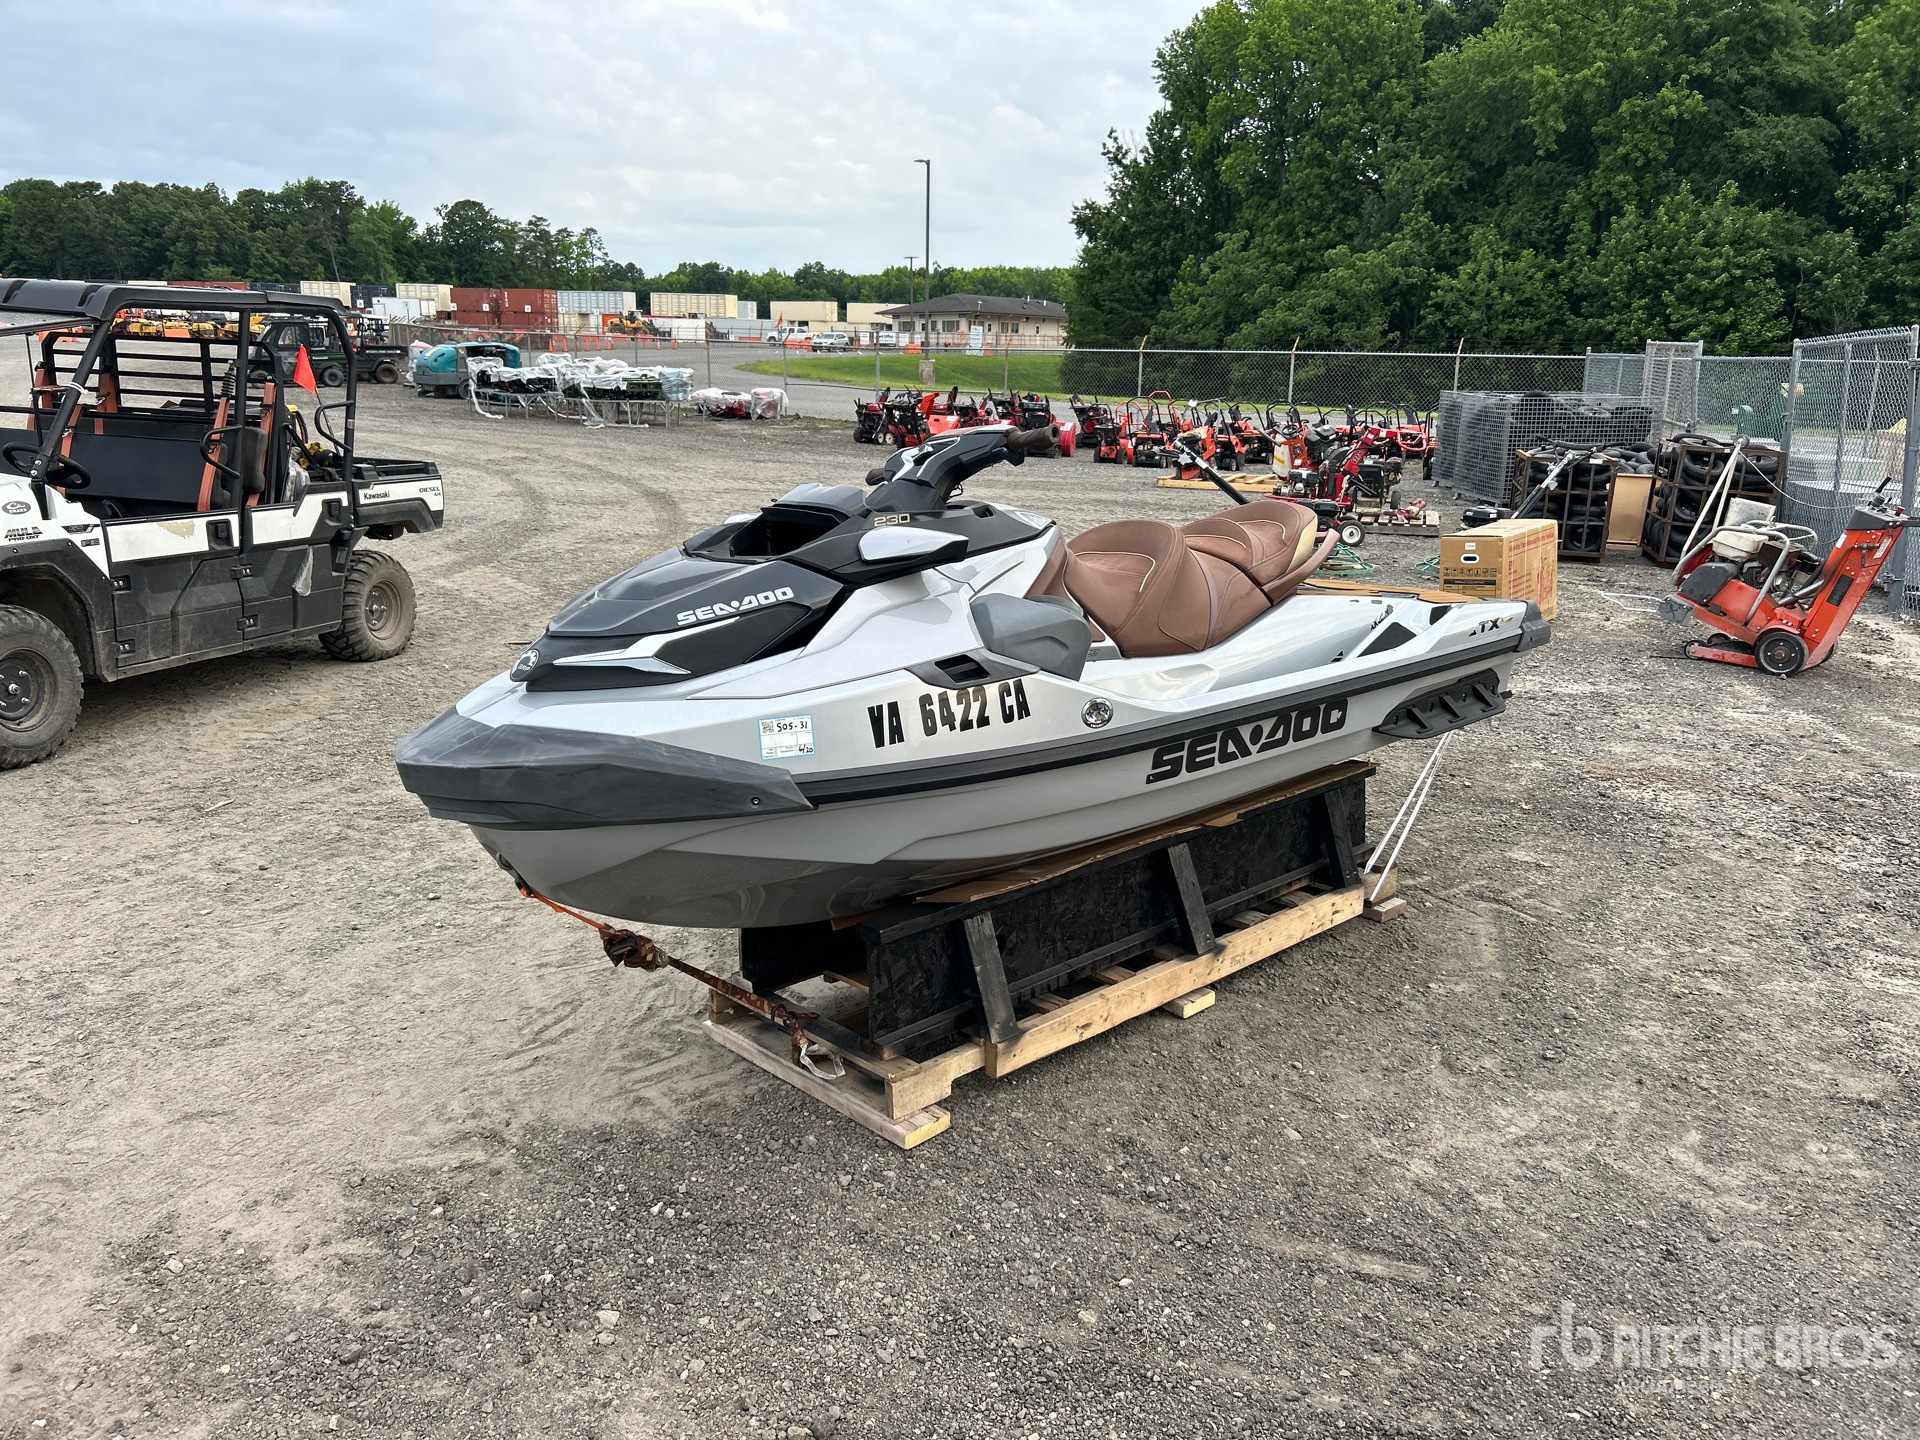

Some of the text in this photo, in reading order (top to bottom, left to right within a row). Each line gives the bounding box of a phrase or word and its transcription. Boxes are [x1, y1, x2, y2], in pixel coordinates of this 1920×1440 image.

[363, 490, 391, 500] Kawasaki
[874, 513, 911, 527] 230
[867, 678, 1032, 749] VA 6422 CA
